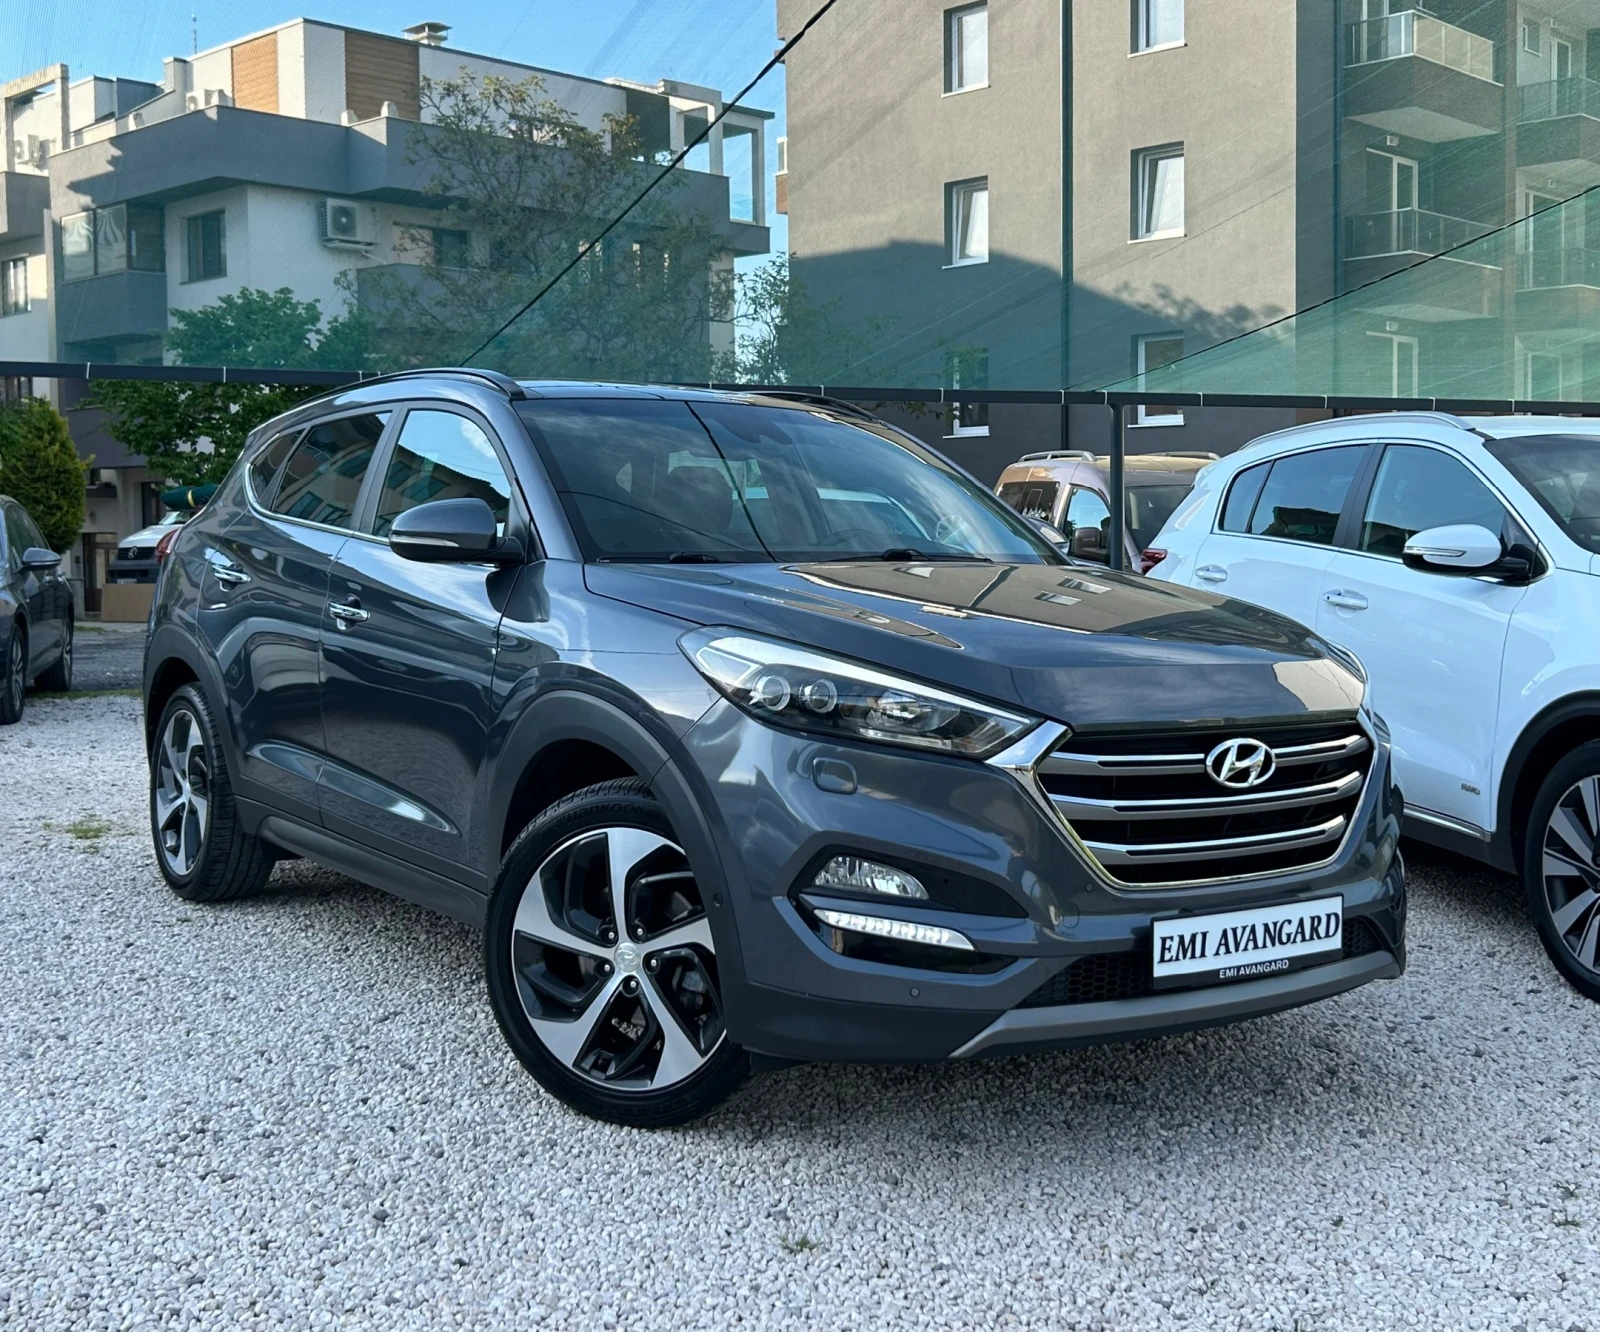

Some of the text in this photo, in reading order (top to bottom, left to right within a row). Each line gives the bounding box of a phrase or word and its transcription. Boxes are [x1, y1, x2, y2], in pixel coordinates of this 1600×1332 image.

[1157, 912, 1340, 964] EMI AVANGARD
[1219, 959, 1289, 979] EMI AVANGARD
